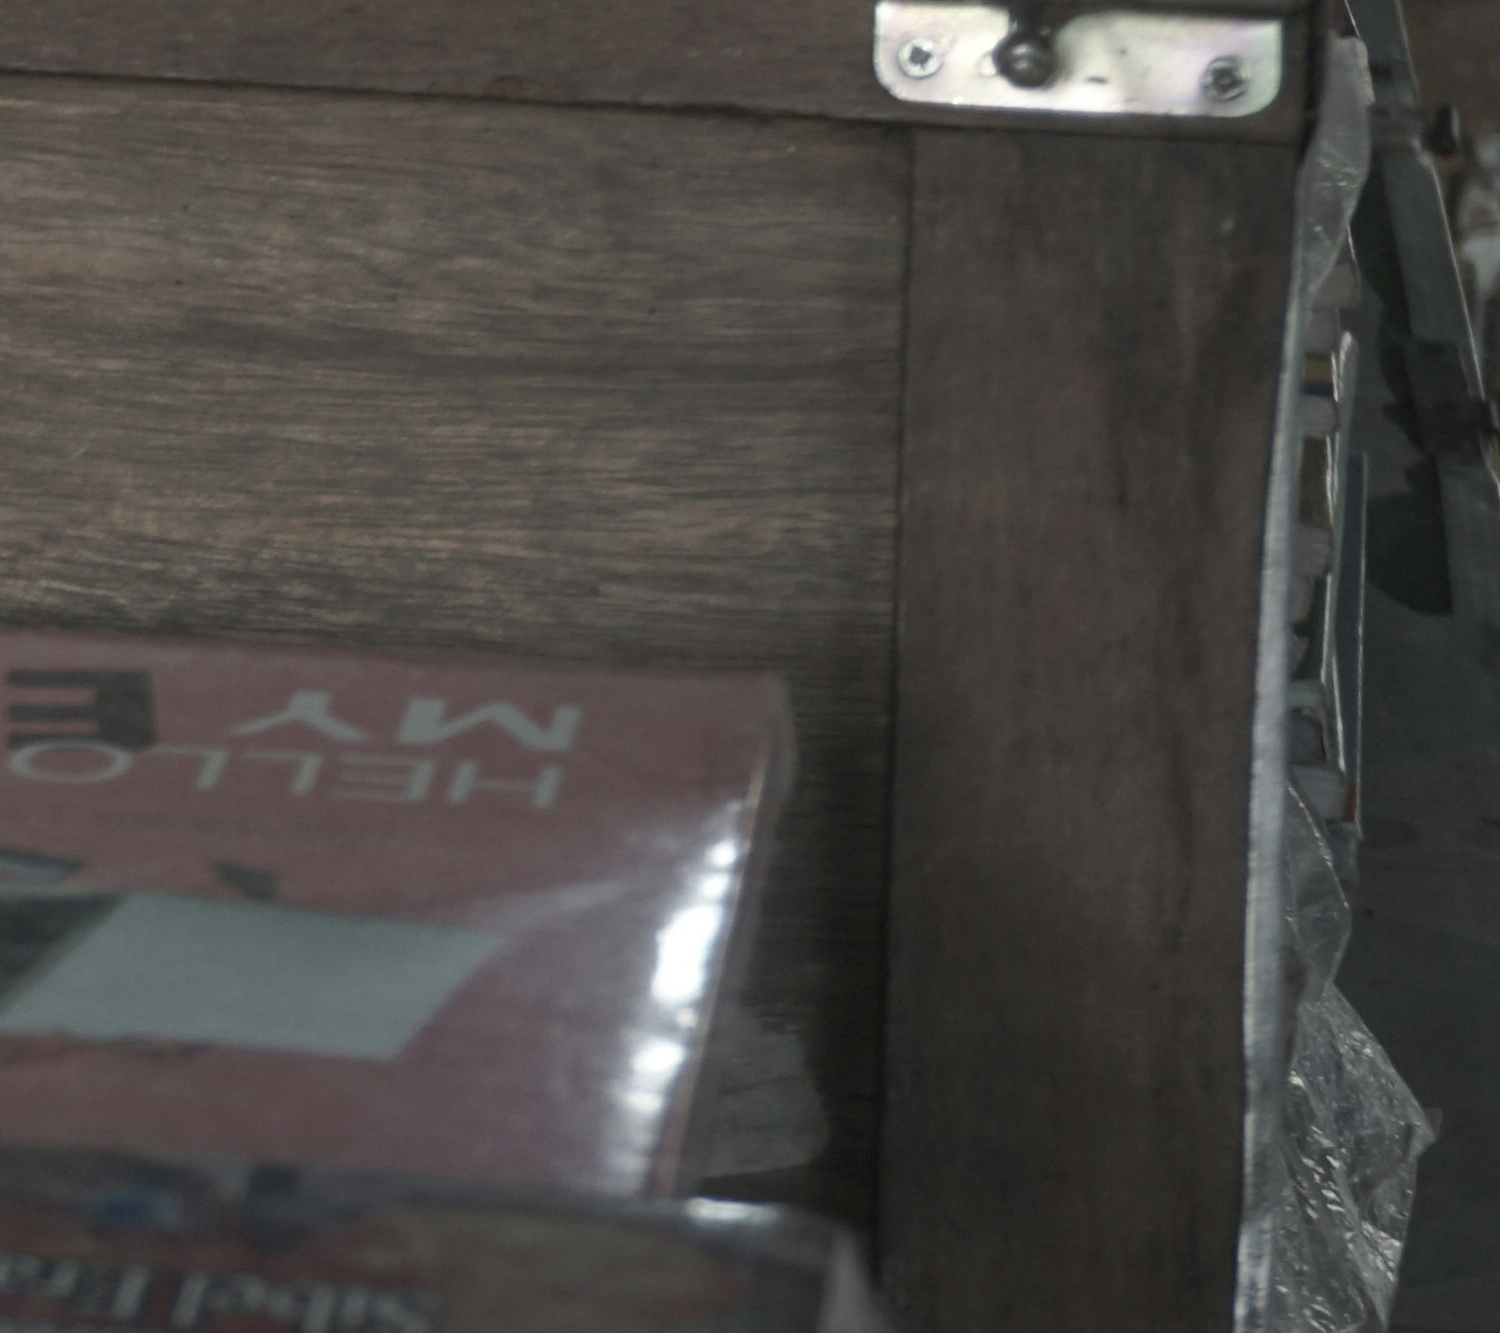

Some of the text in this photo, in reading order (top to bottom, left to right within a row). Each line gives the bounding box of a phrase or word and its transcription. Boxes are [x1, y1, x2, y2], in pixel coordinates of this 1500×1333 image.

[228, 689, 582, 751] MY
[7, 743, 565, 810] HELLO
[169, 1270, 446, 1333] Sibel
